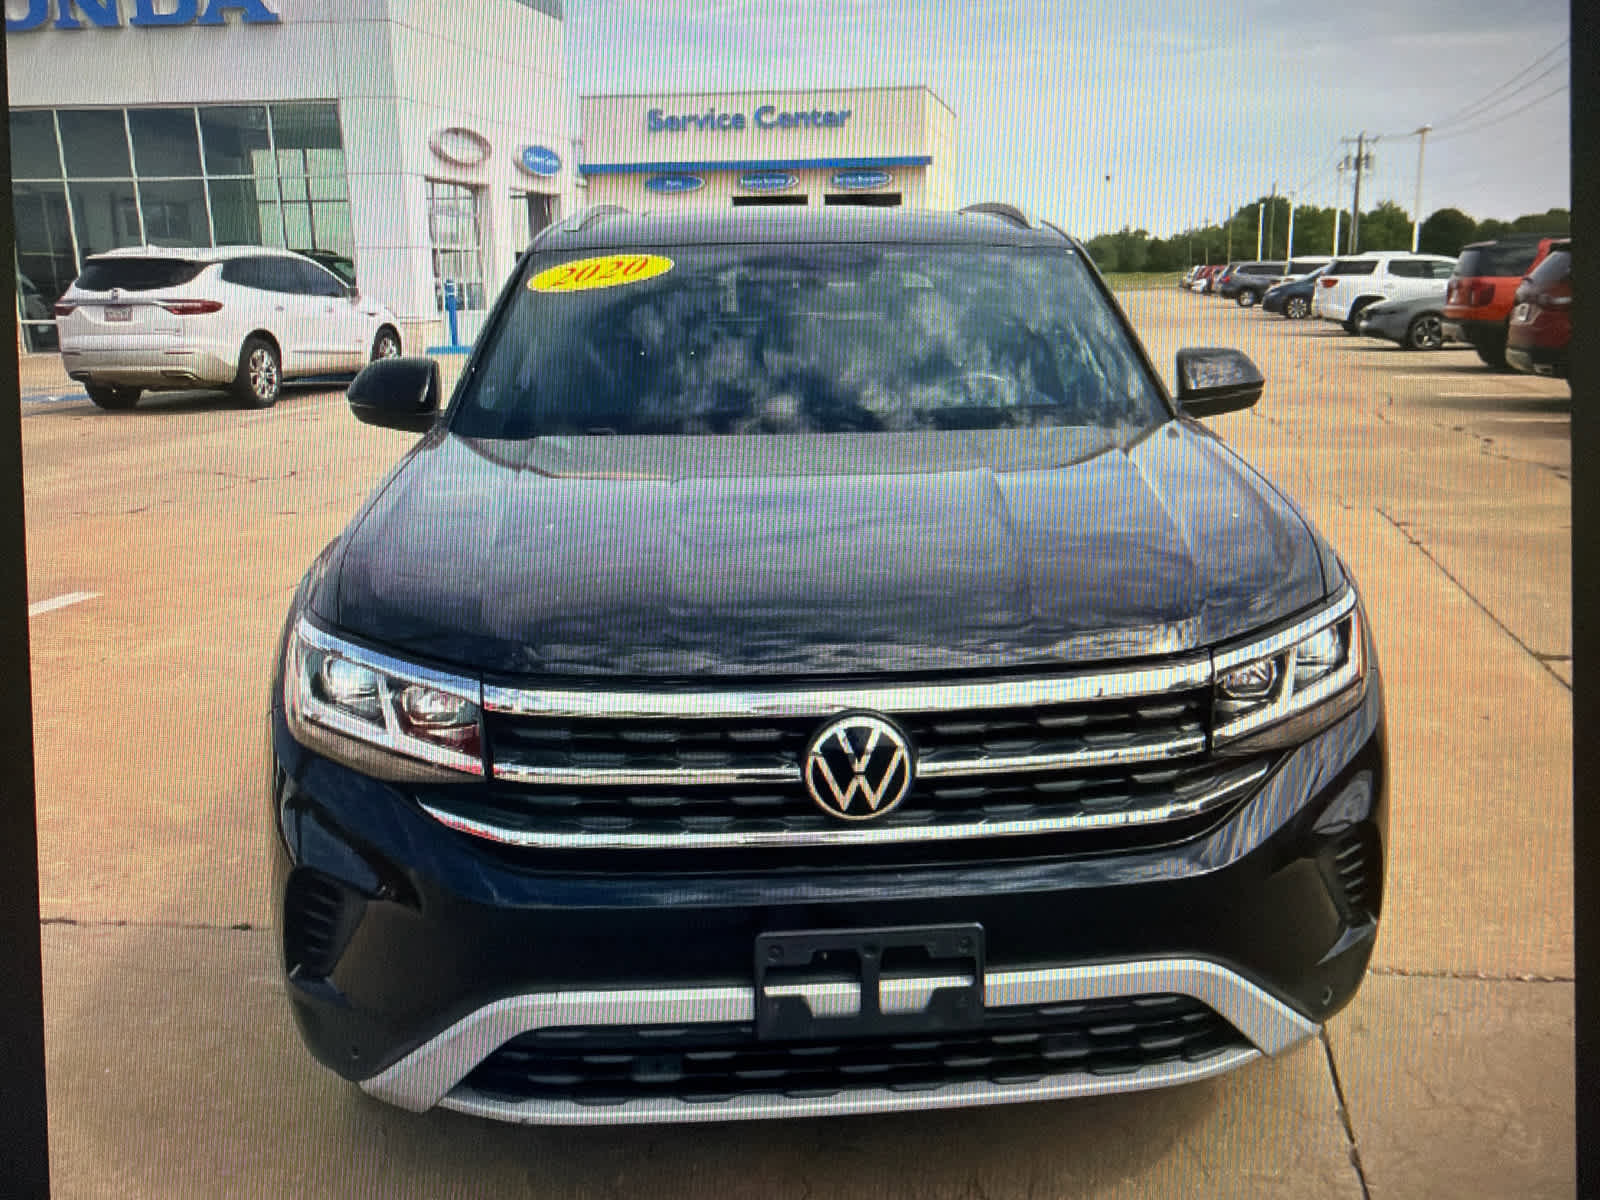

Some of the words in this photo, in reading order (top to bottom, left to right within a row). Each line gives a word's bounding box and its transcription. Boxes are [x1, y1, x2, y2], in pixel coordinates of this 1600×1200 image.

[648, 107, 746, 132] Service
[754, 105, 851, 129] Center
[551, 256, 649, 287] 2020
